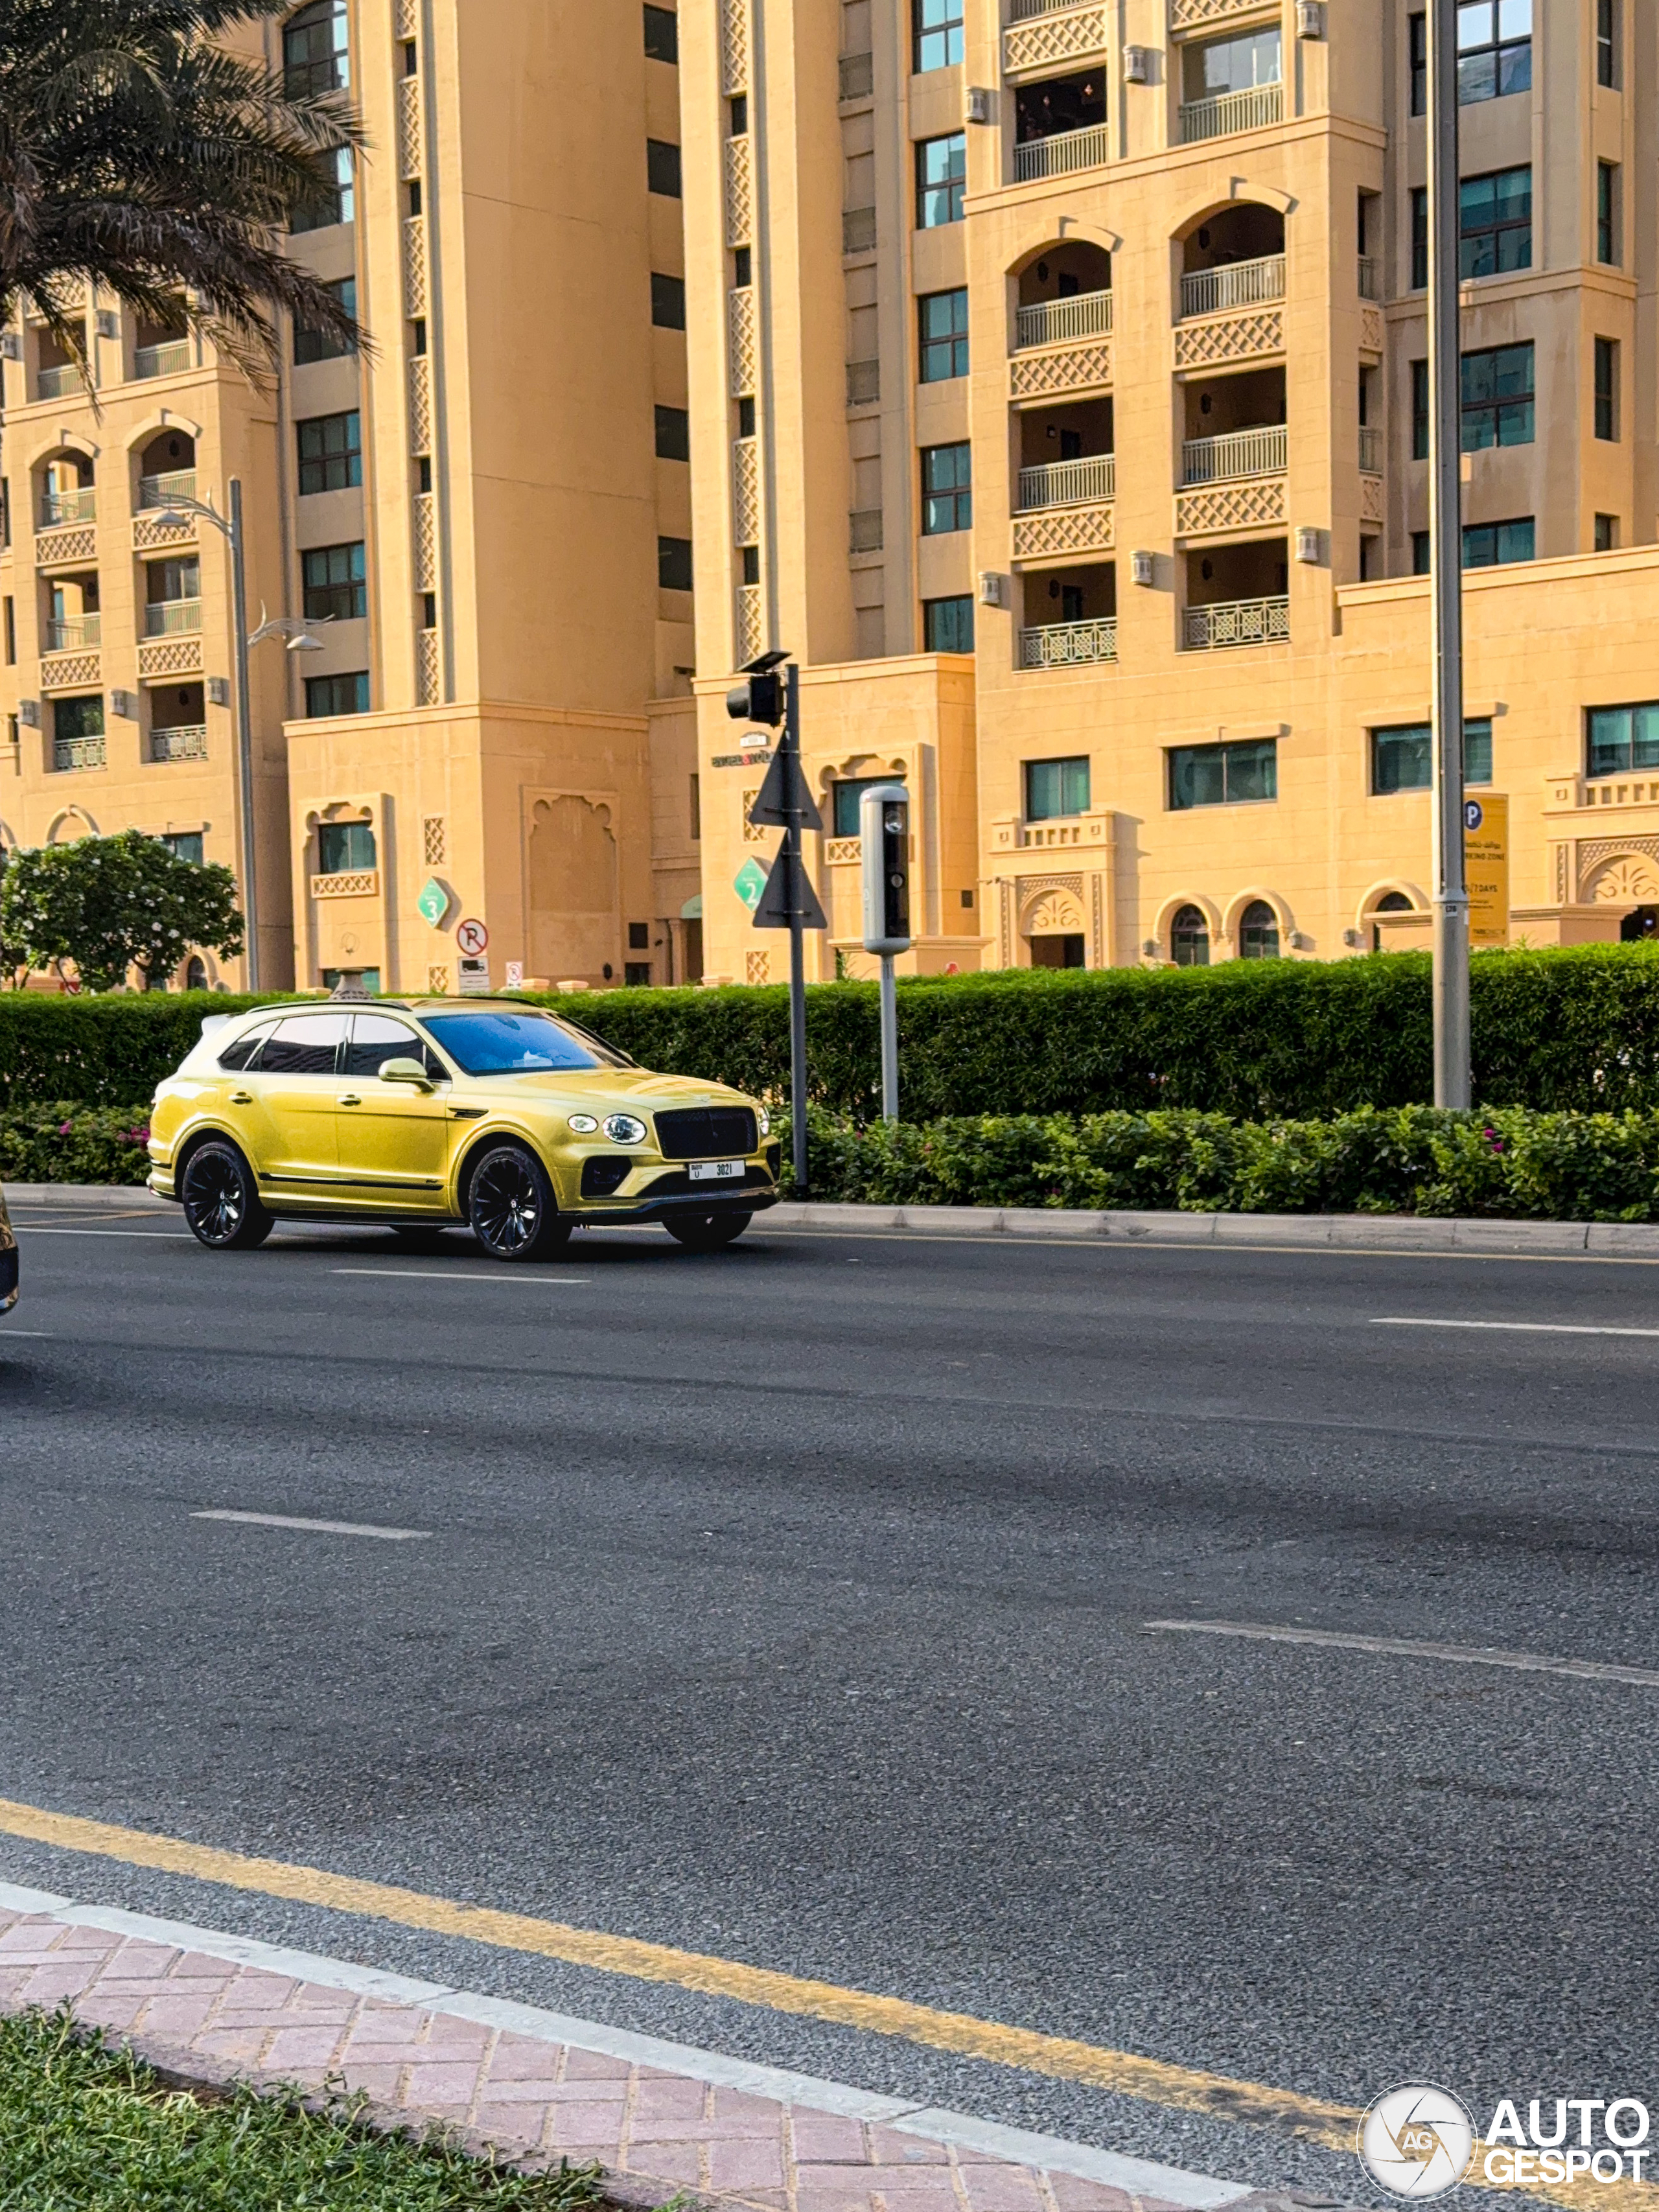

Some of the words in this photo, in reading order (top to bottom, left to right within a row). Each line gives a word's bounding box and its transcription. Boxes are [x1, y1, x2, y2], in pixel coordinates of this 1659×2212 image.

[1467, 806, 1478, 825] P
[747, 882, 756, 903] 2
[428, 901, 437, 921] 3
[717, 1163, 732, 1175] 3021
